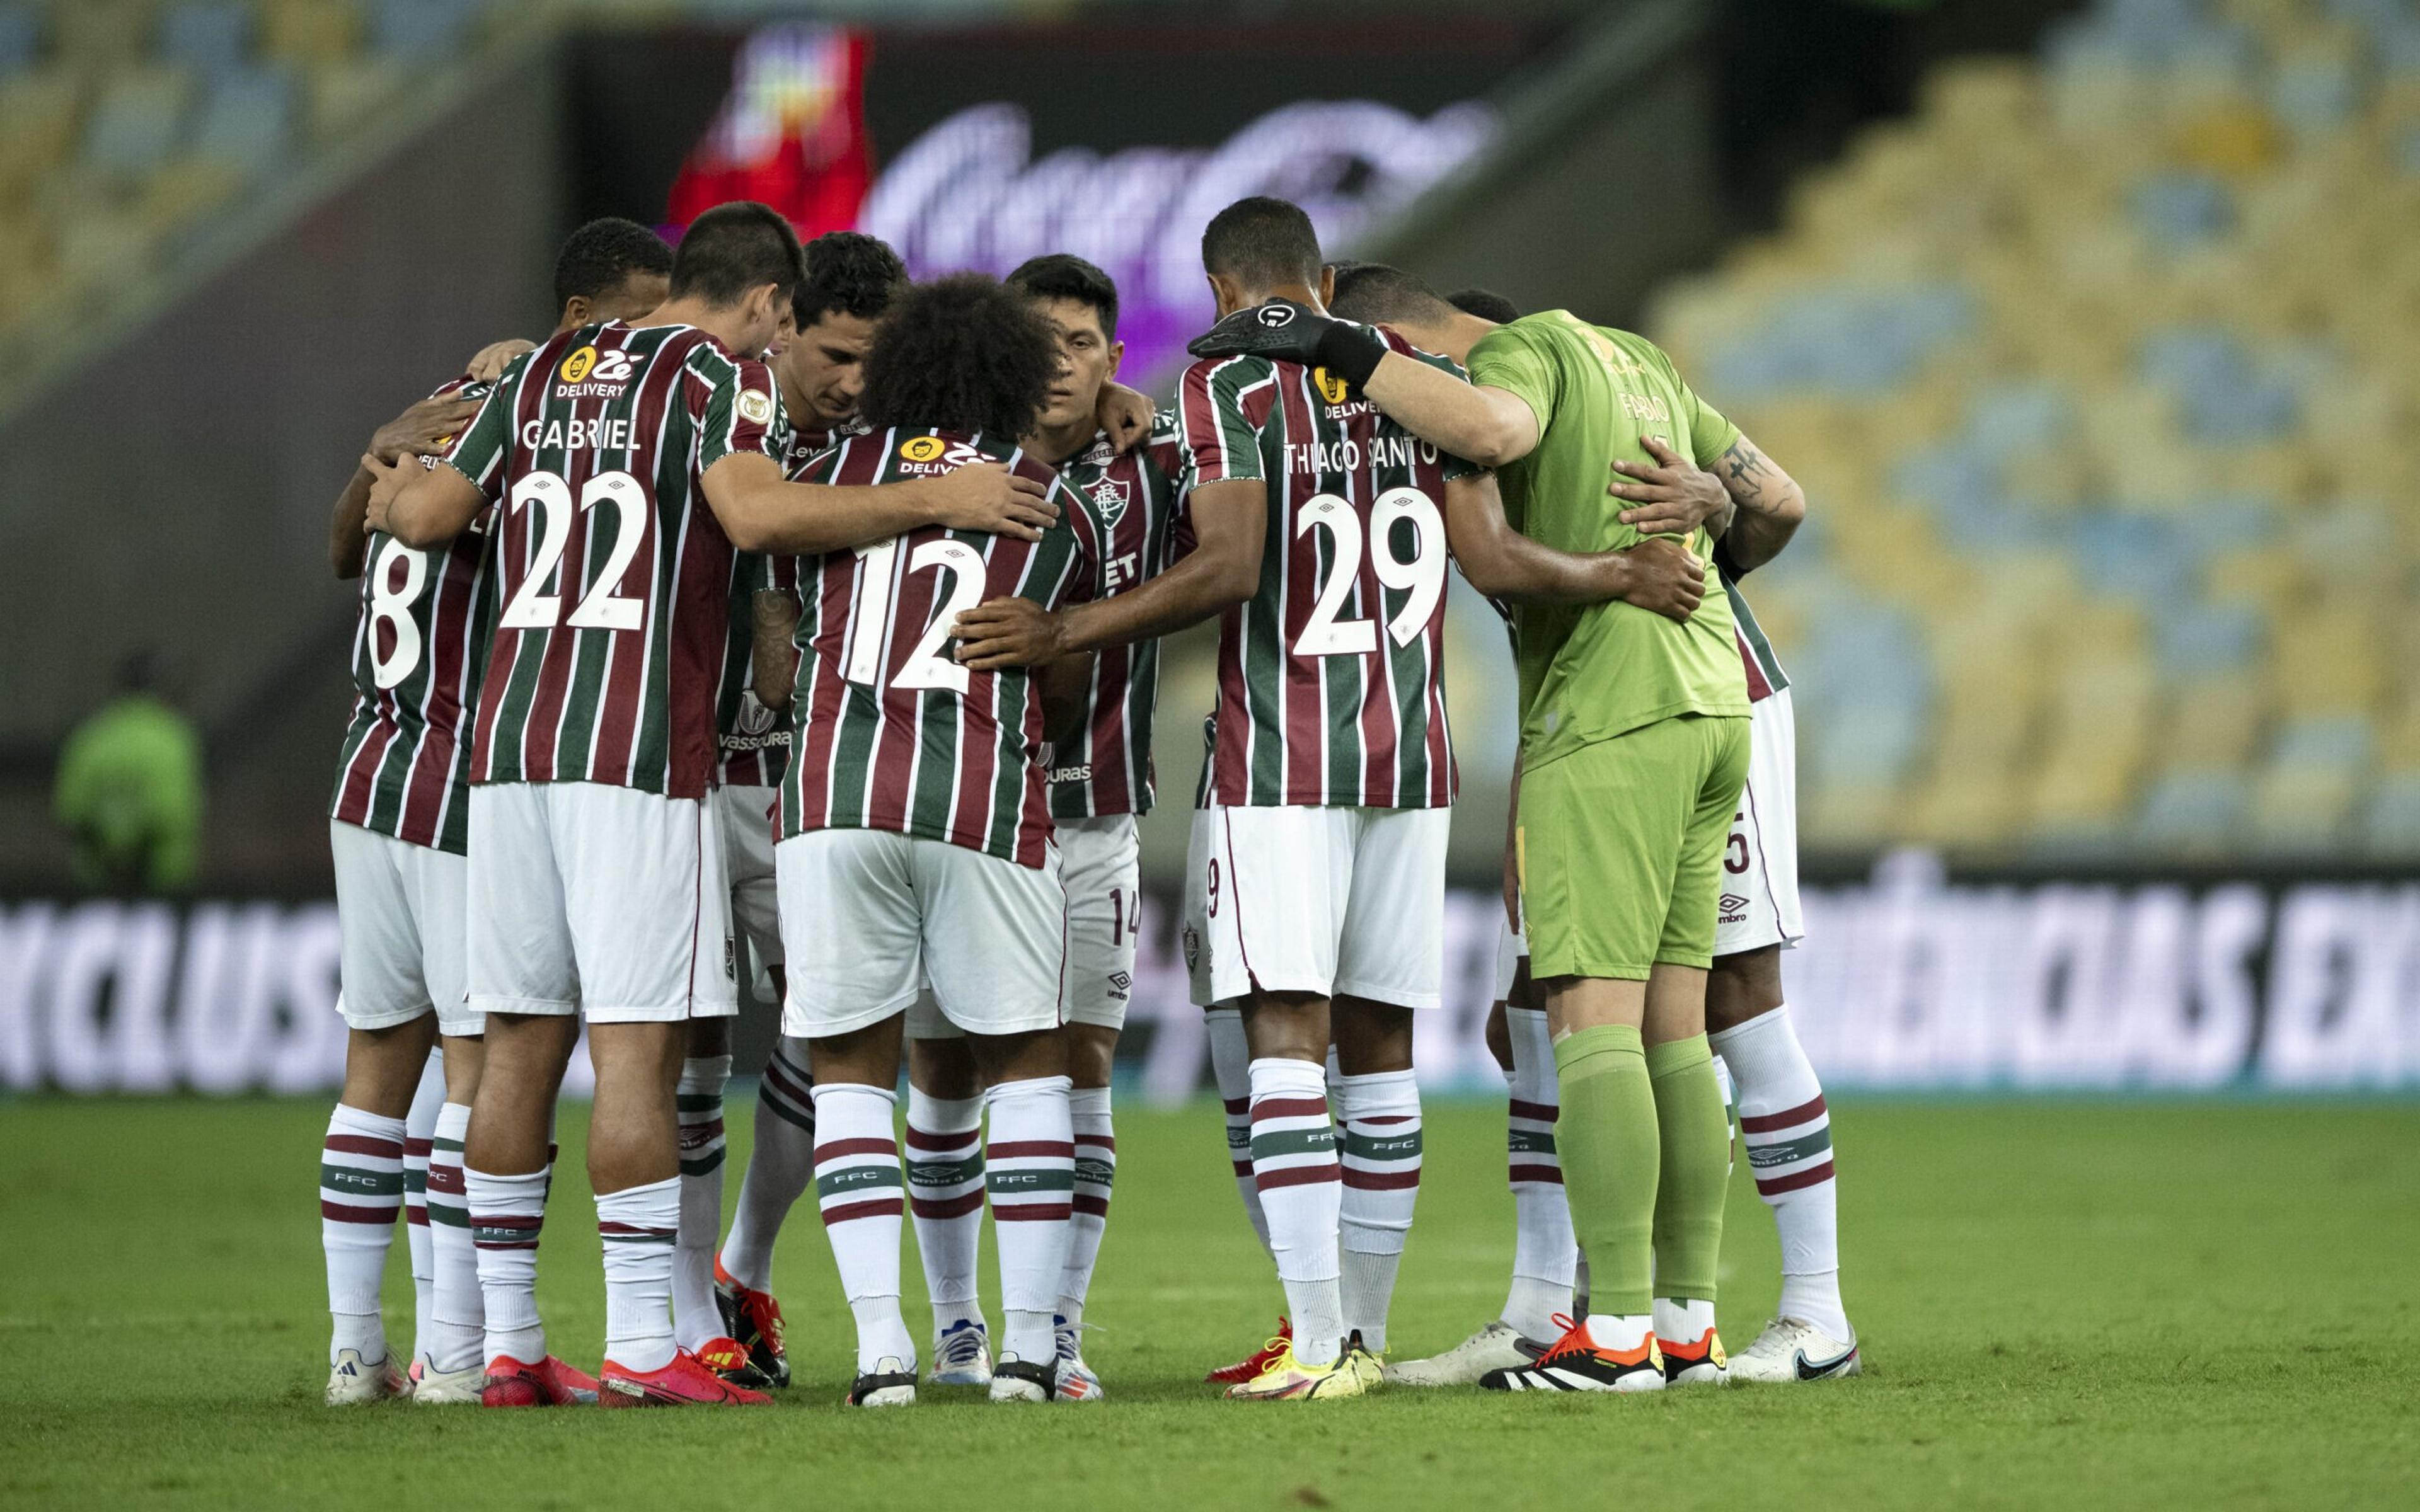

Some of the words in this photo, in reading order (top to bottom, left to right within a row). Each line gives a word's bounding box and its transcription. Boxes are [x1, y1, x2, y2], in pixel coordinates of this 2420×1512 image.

[556, 383, 626, 397] DELIVERY
[1325, 400, 1382, 419] DELIVE
[522, 418, 641, 450] GABRIEL
[786, 443, 826, 458] Lev
[1284, 440, 1360, 474] THIAGO
[899, 462, 958, 475] DELIV
[499, 471, 647, 631] 22
[1292, 486, 1448, 655] 29
[368, 537, 427, 689] 8
[846, 537, 988, 694] 12
[1109, 888, 1141, 949] 14
[1372, 1139, 1415, 1150] FFC
[334, 1172, 377, 1188] FFC
[834, 1171, 878, 1184] FFC
[996, 1175, 1038, 1184] FFC
[482, 1227, 518, 1235] FFC
